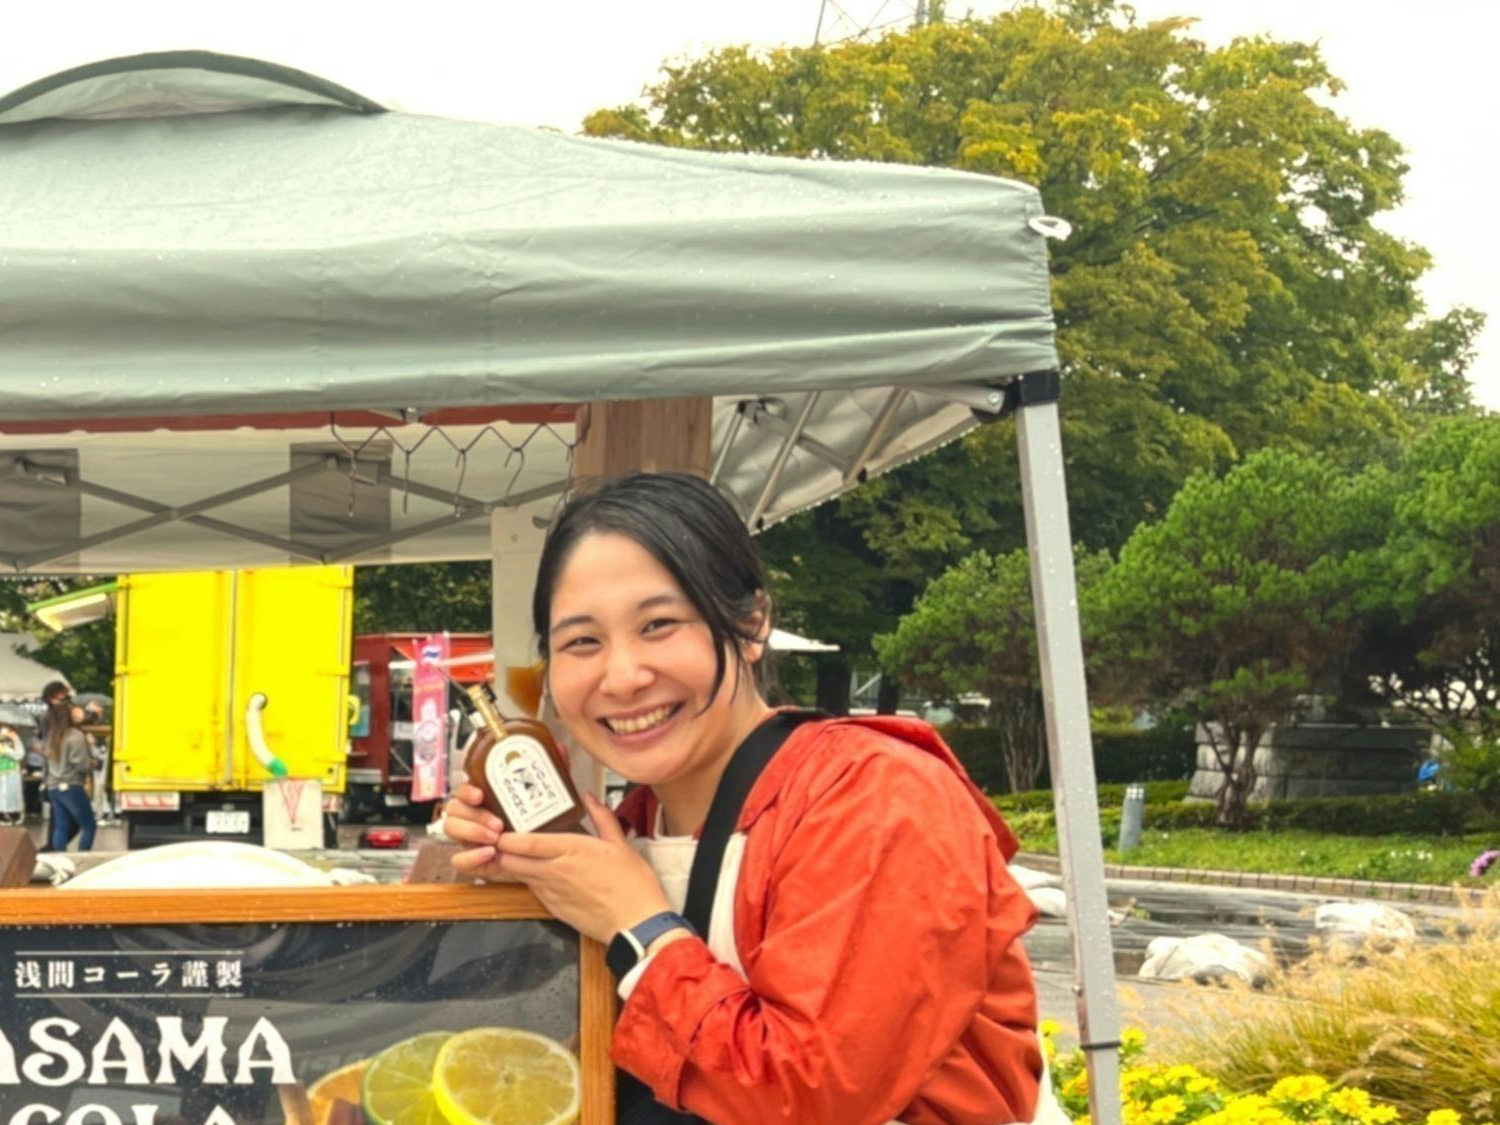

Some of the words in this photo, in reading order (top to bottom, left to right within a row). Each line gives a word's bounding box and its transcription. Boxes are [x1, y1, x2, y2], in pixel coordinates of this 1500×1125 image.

[15, 959, 243, 990] 浅間コーラ謹製
